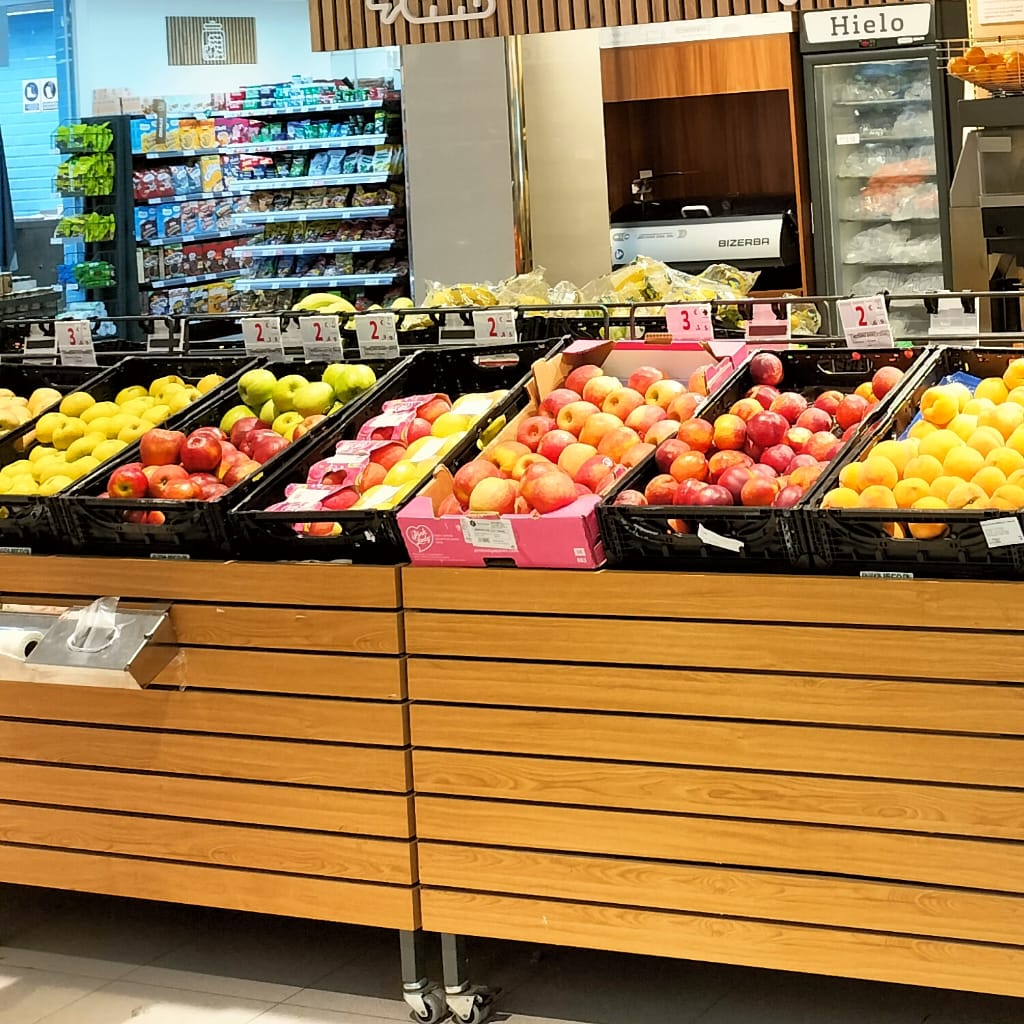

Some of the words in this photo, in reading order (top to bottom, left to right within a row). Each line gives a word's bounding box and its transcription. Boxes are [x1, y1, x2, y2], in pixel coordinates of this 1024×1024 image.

[830, 12, 905, 36] Hielo
[718, 237, 770, 247] BIZERBA
[681, 310, 691, 330] 3
[855, 306, 867, 326] 2
[67, 328, 76, 345] 3
[255, 323, 264, 342] 2
[313, 323, 323, 341] 2
[369, 321, 379, 340] 2
[487, 317, 497, 337] 2
